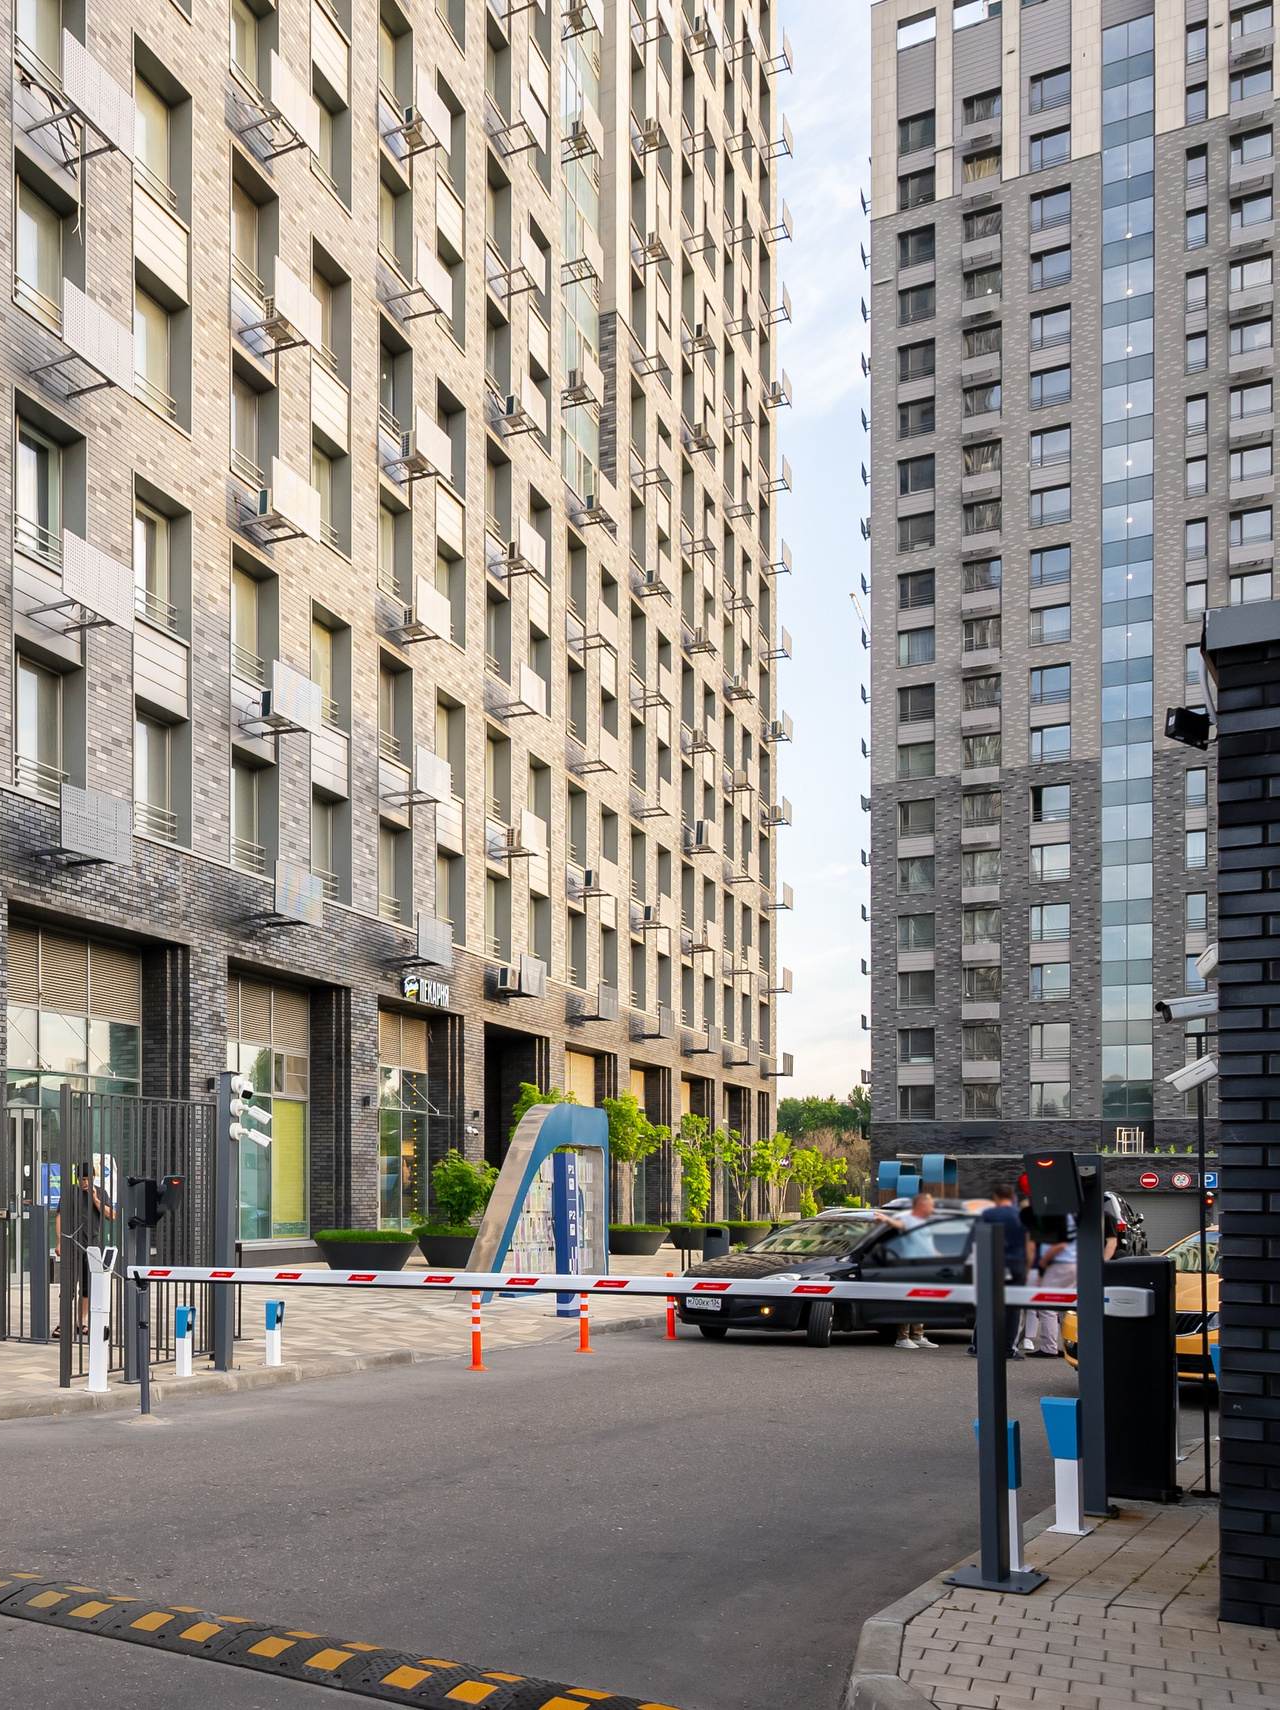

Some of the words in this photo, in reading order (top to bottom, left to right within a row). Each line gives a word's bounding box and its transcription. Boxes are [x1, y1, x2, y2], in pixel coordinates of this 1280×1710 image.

[419, 978, 450, 1008] ПЕКАРНЯ
[567, 1164, 575, 1175] P1
[1204, 1174, 1215, 1186] P
[568, 1209, 577, 1221] P2
